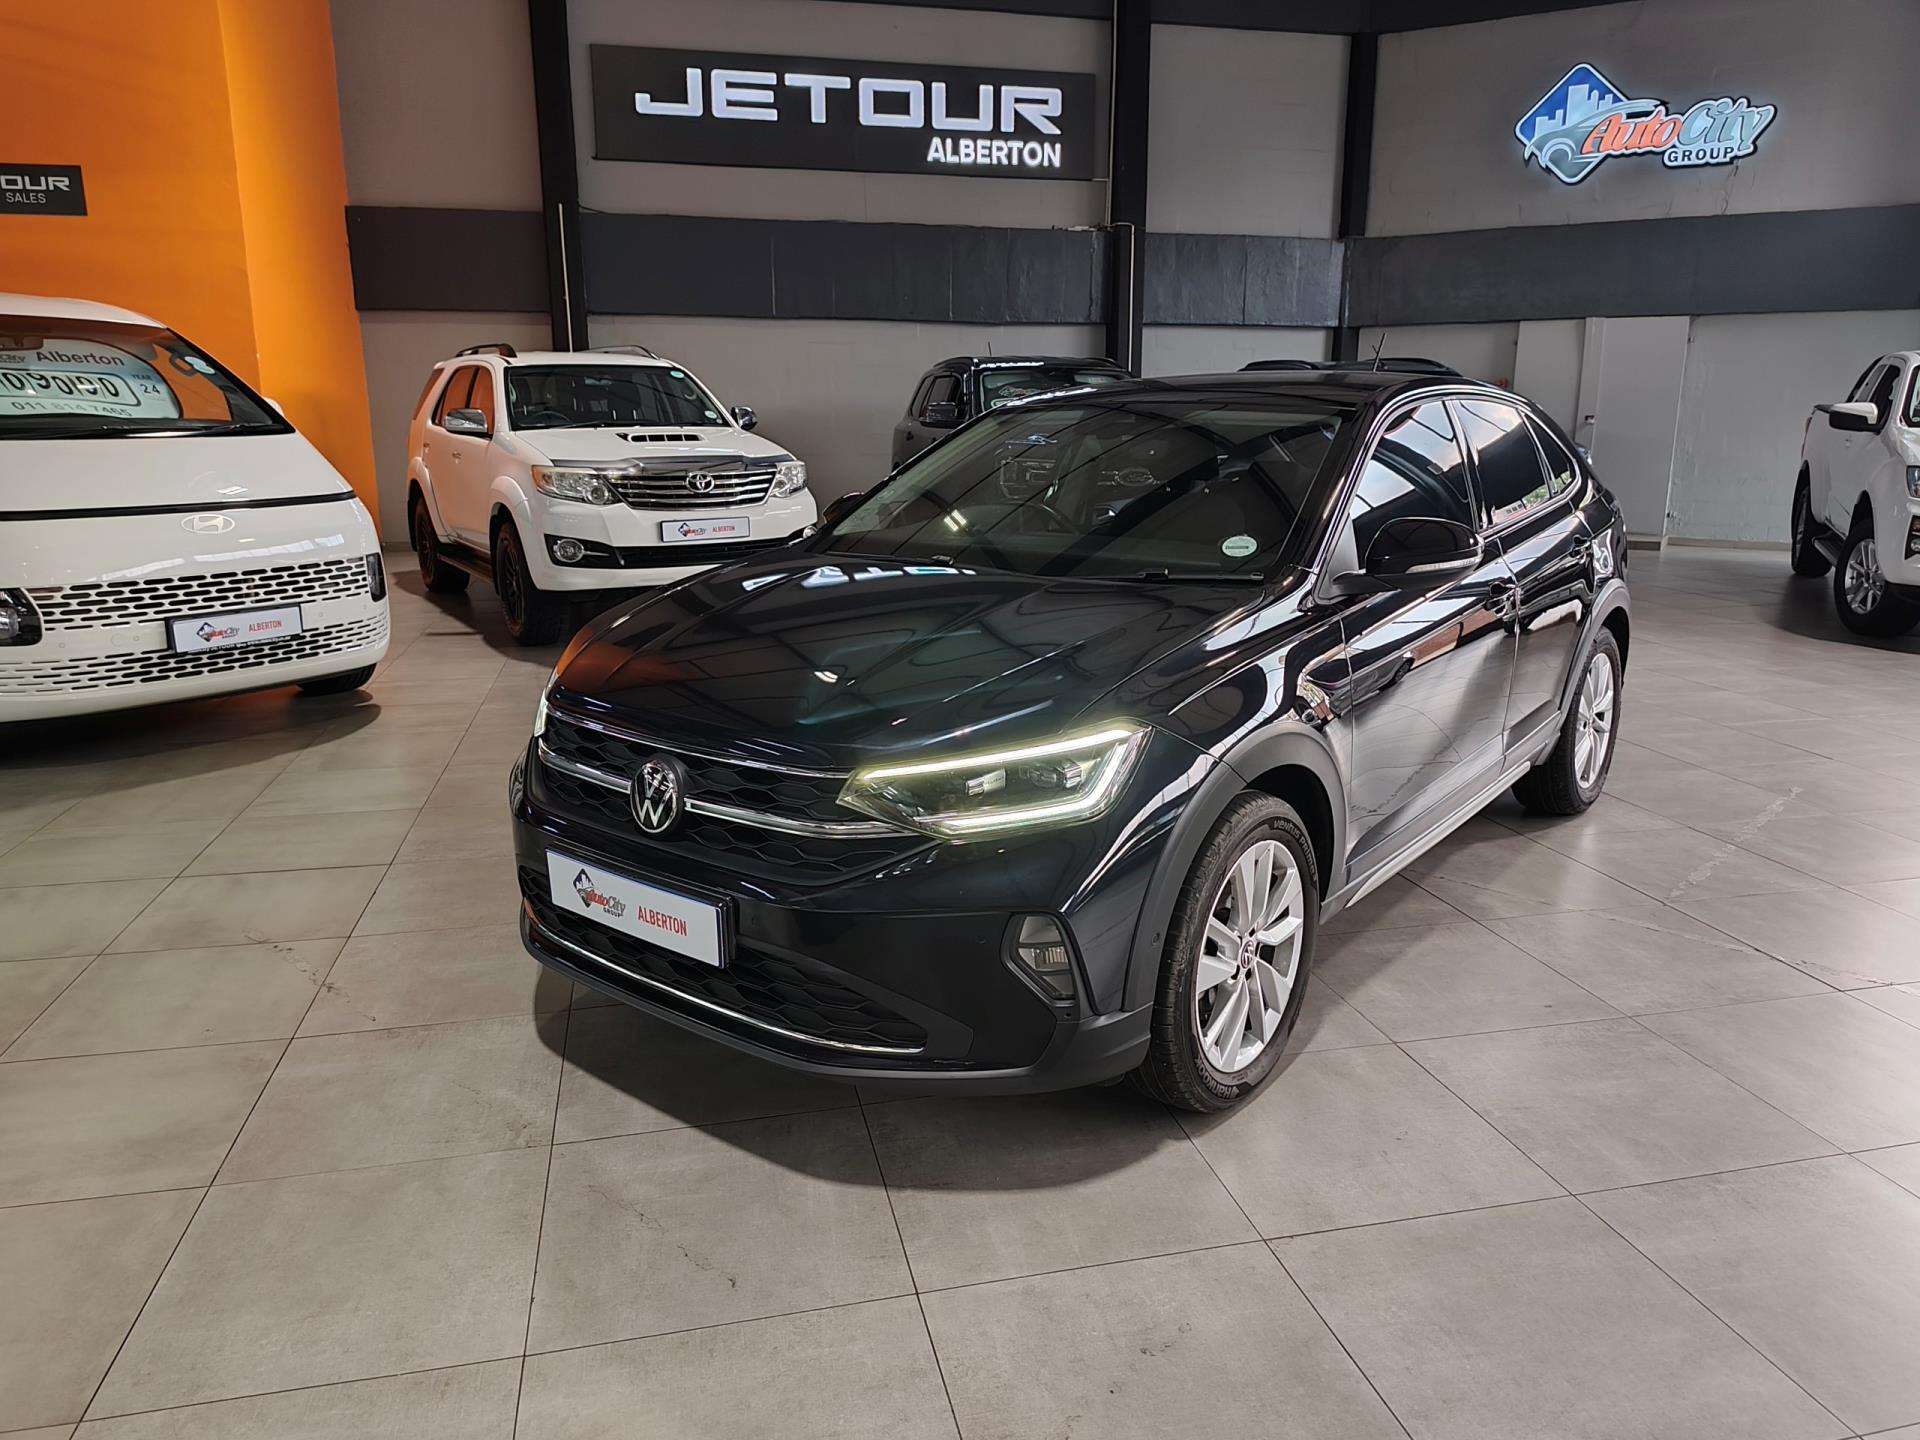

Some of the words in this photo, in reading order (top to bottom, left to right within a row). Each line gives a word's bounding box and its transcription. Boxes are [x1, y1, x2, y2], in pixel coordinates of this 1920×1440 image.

[634, 67, 1063, 136] JETOUR
[1579, 99, 1774, 155] AutoCity
[926, 135, 1062, 169] ALBERTON
[1667, 146, 1736, 163] GROUP
[6, 192, 47, 204] SALES
[36, 351, 125, 367] Alberton
[139, 383, 161, 394] 24
[248, 620, 282, 633] ALBERTON
[638, 905, 688, 936] ALBERTON
